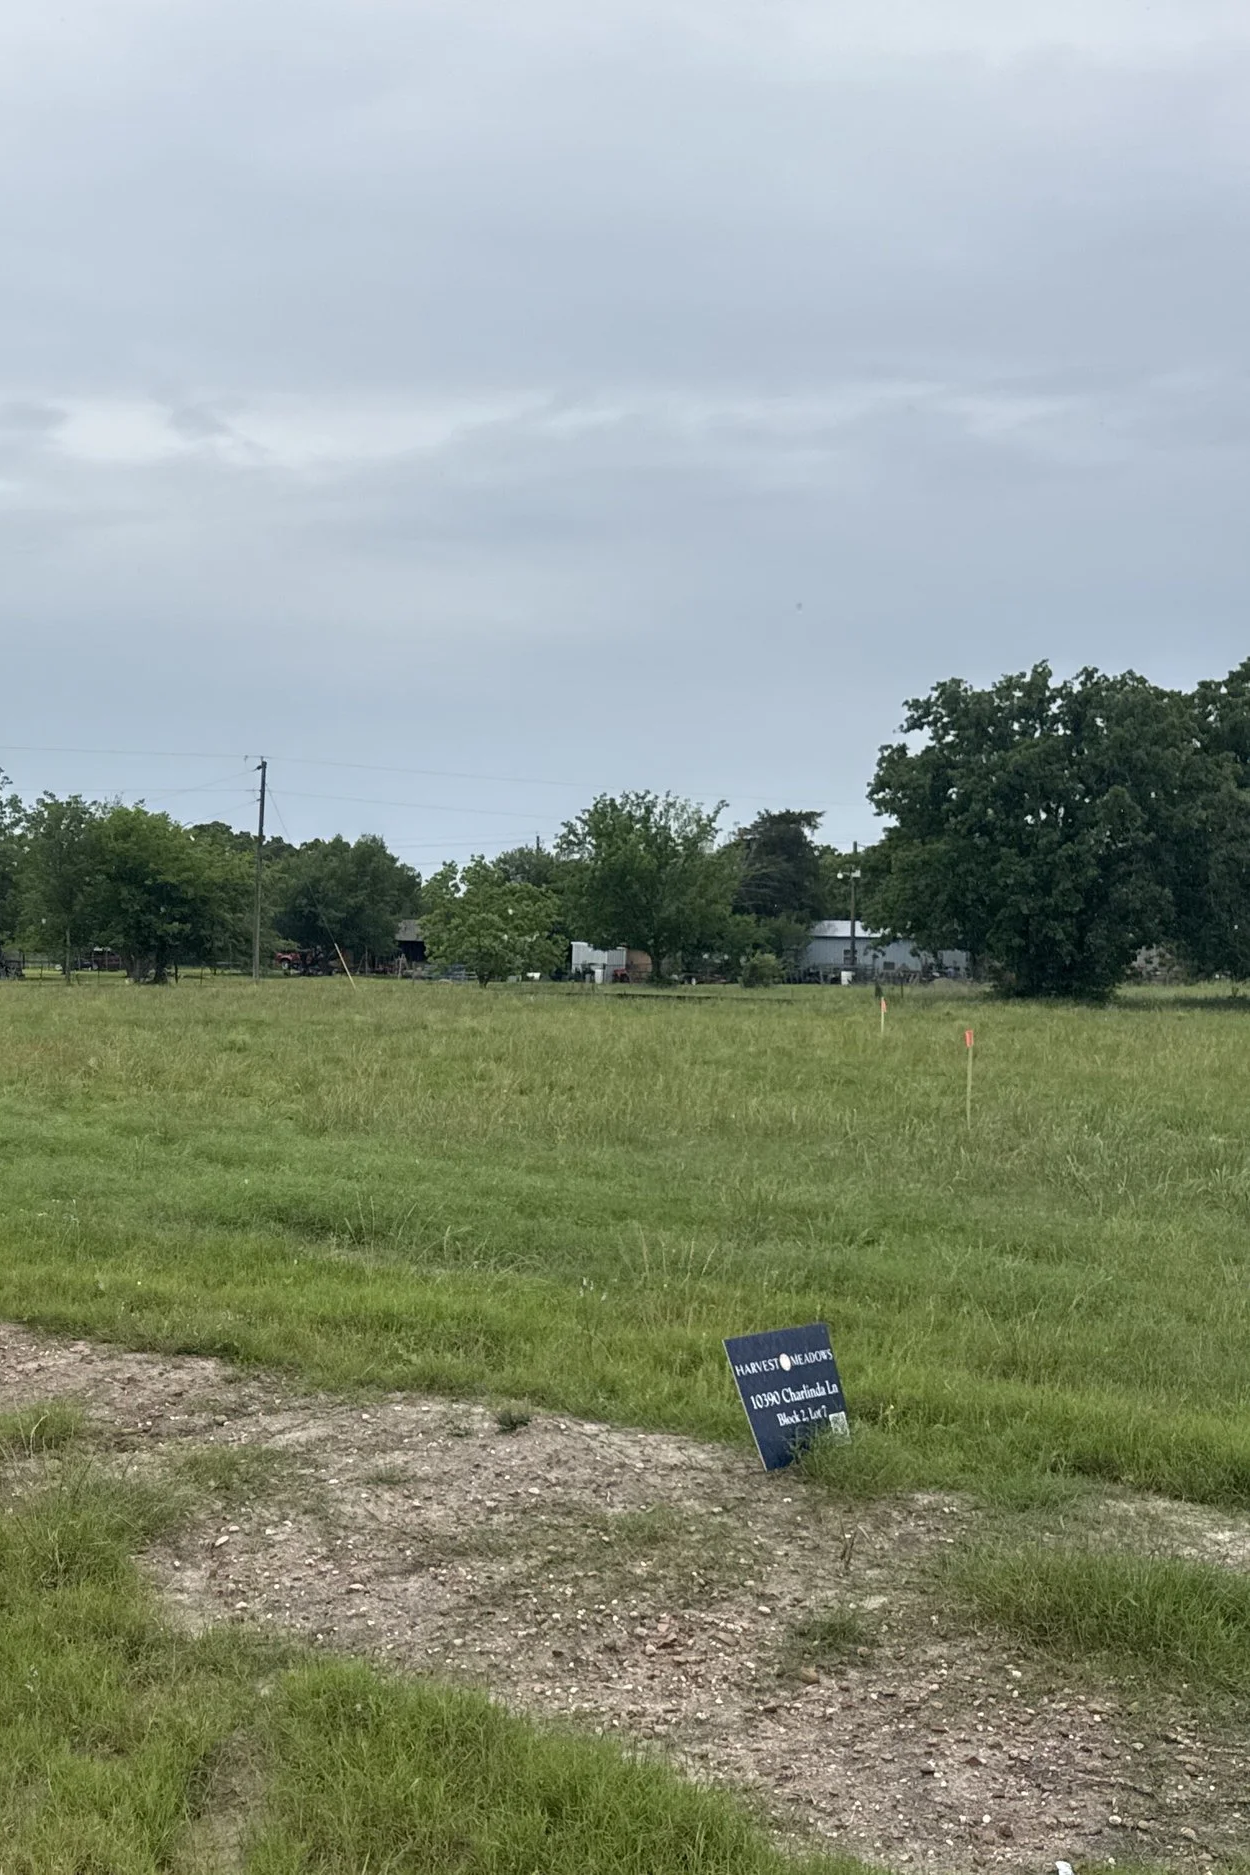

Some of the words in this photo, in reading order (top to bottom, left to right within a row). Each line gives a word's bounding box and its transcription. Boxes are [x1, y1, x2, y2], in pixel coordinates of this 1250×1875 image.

[735, 1358, 780, 1376] HARVEST
[790, 1349, 833, 1367] MEADOWS
[750, 1390, 781, 1409] 10390
[781, 1382, 825, 1403] Charlinda
[825, 1380, 839, 1394] Ln
[776, 1410, 800, 1426] Block
